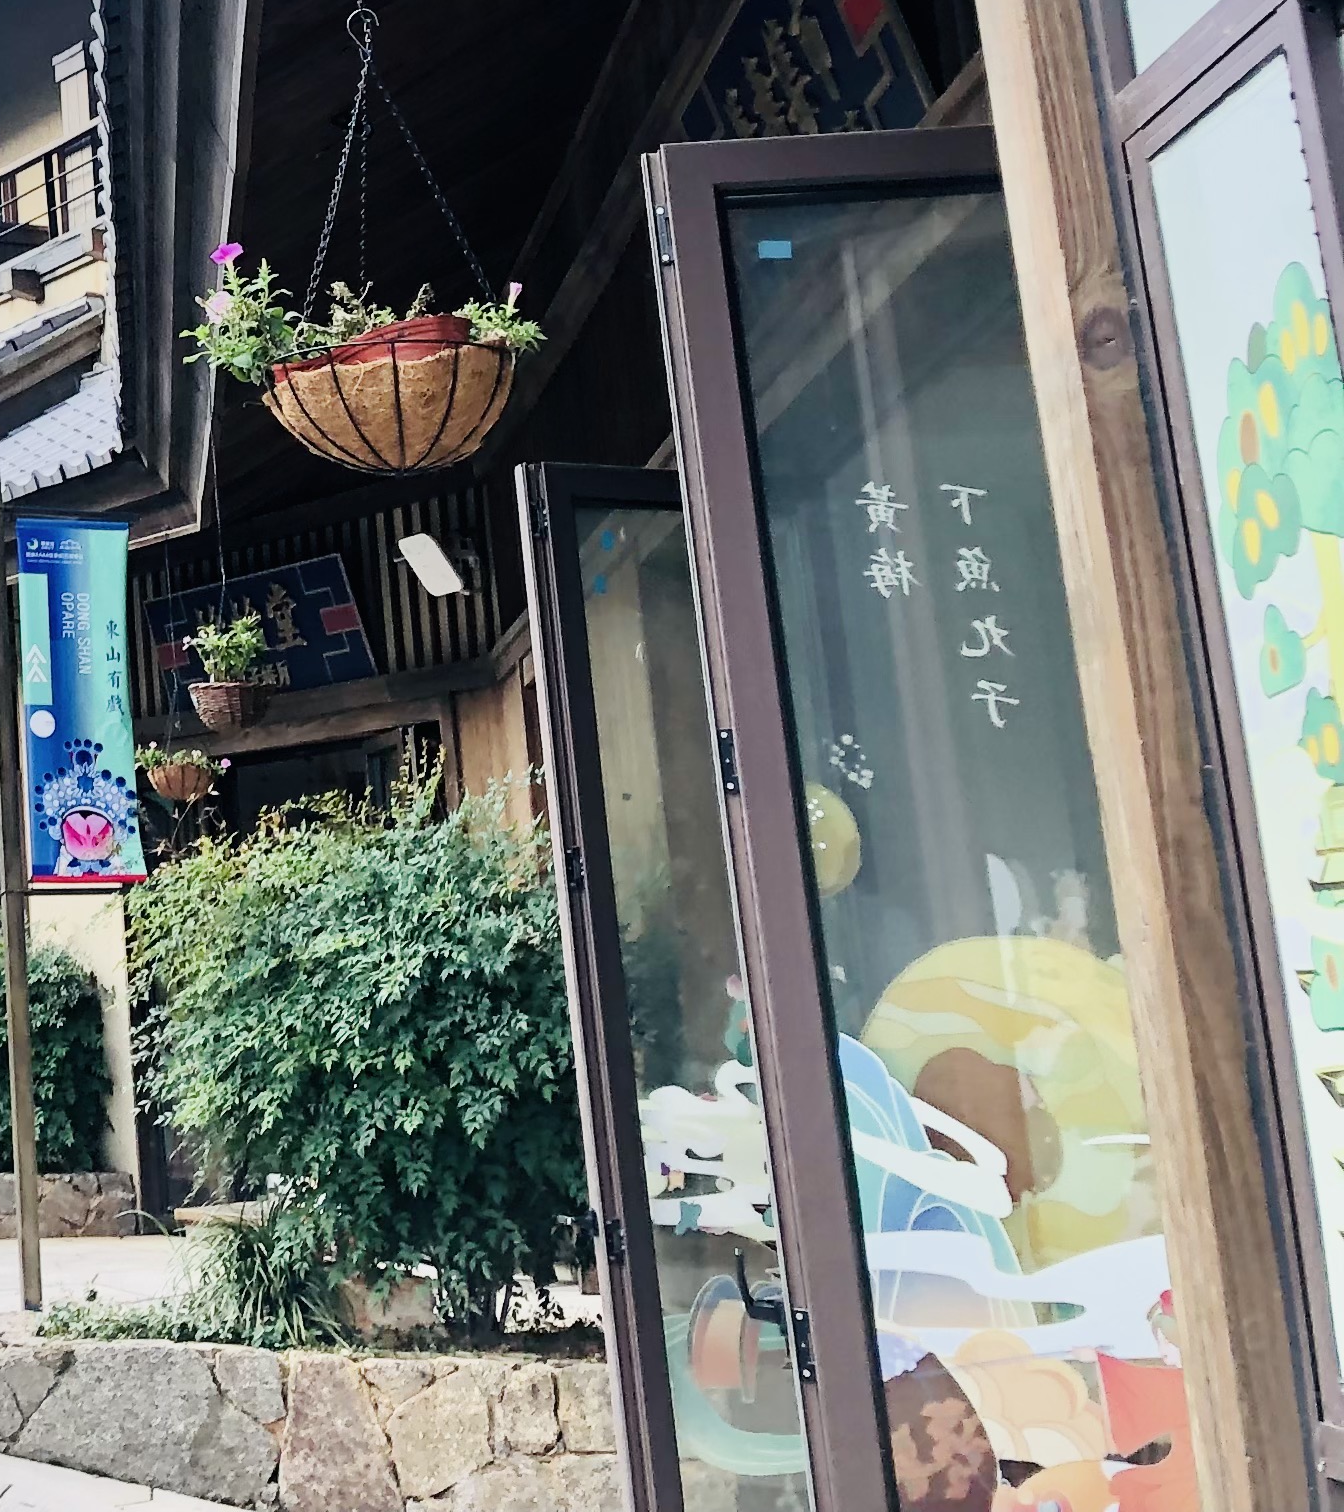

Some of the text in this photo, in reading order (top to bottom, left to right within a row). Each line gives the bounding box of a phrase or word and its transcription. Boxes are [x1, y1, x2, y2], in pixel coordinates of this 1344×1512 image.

[61, 591, 76, 640] OPARE
[76, 592, 92, 675] DONG SHAN
